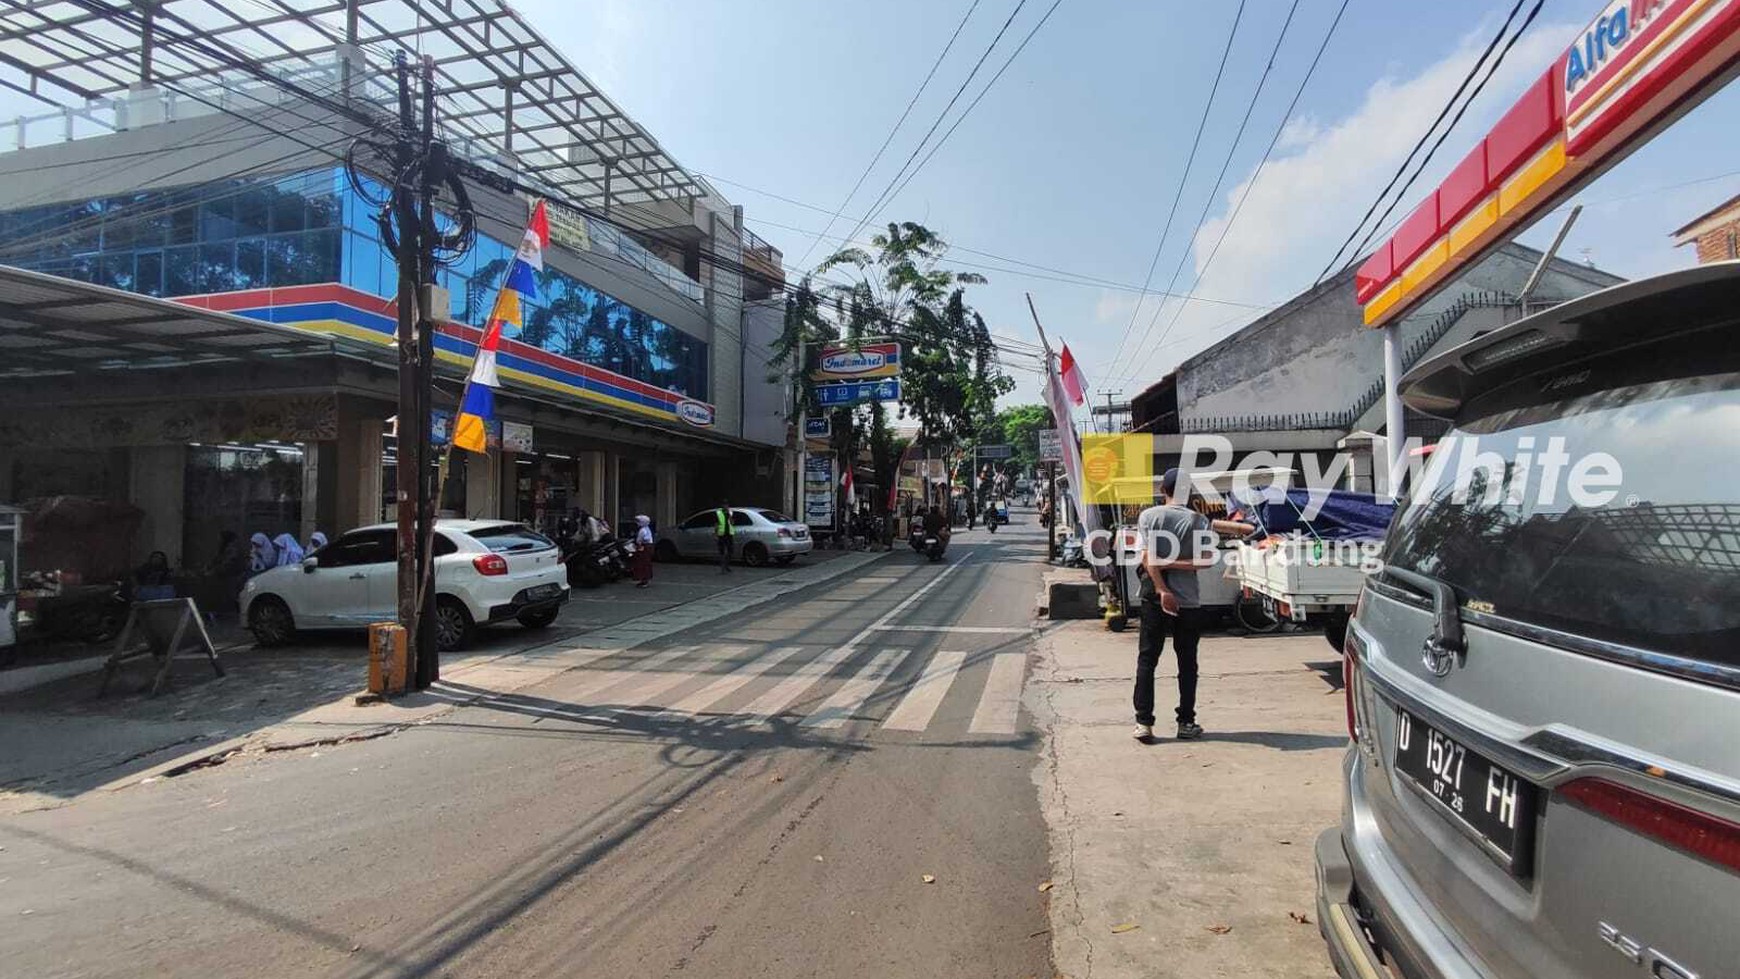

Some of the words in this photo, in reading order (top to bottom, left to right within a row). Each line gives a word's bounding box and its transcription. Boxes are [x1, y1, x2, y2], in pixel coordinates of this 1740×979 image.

[1400, 711, 1411, 751] D
[1427, 728, 1466, 790] 1527
[1486, 766, 1517, 829] FH
[1433, 779, 1445, 798] 07
[1451, 792, 1463, 812] 26
